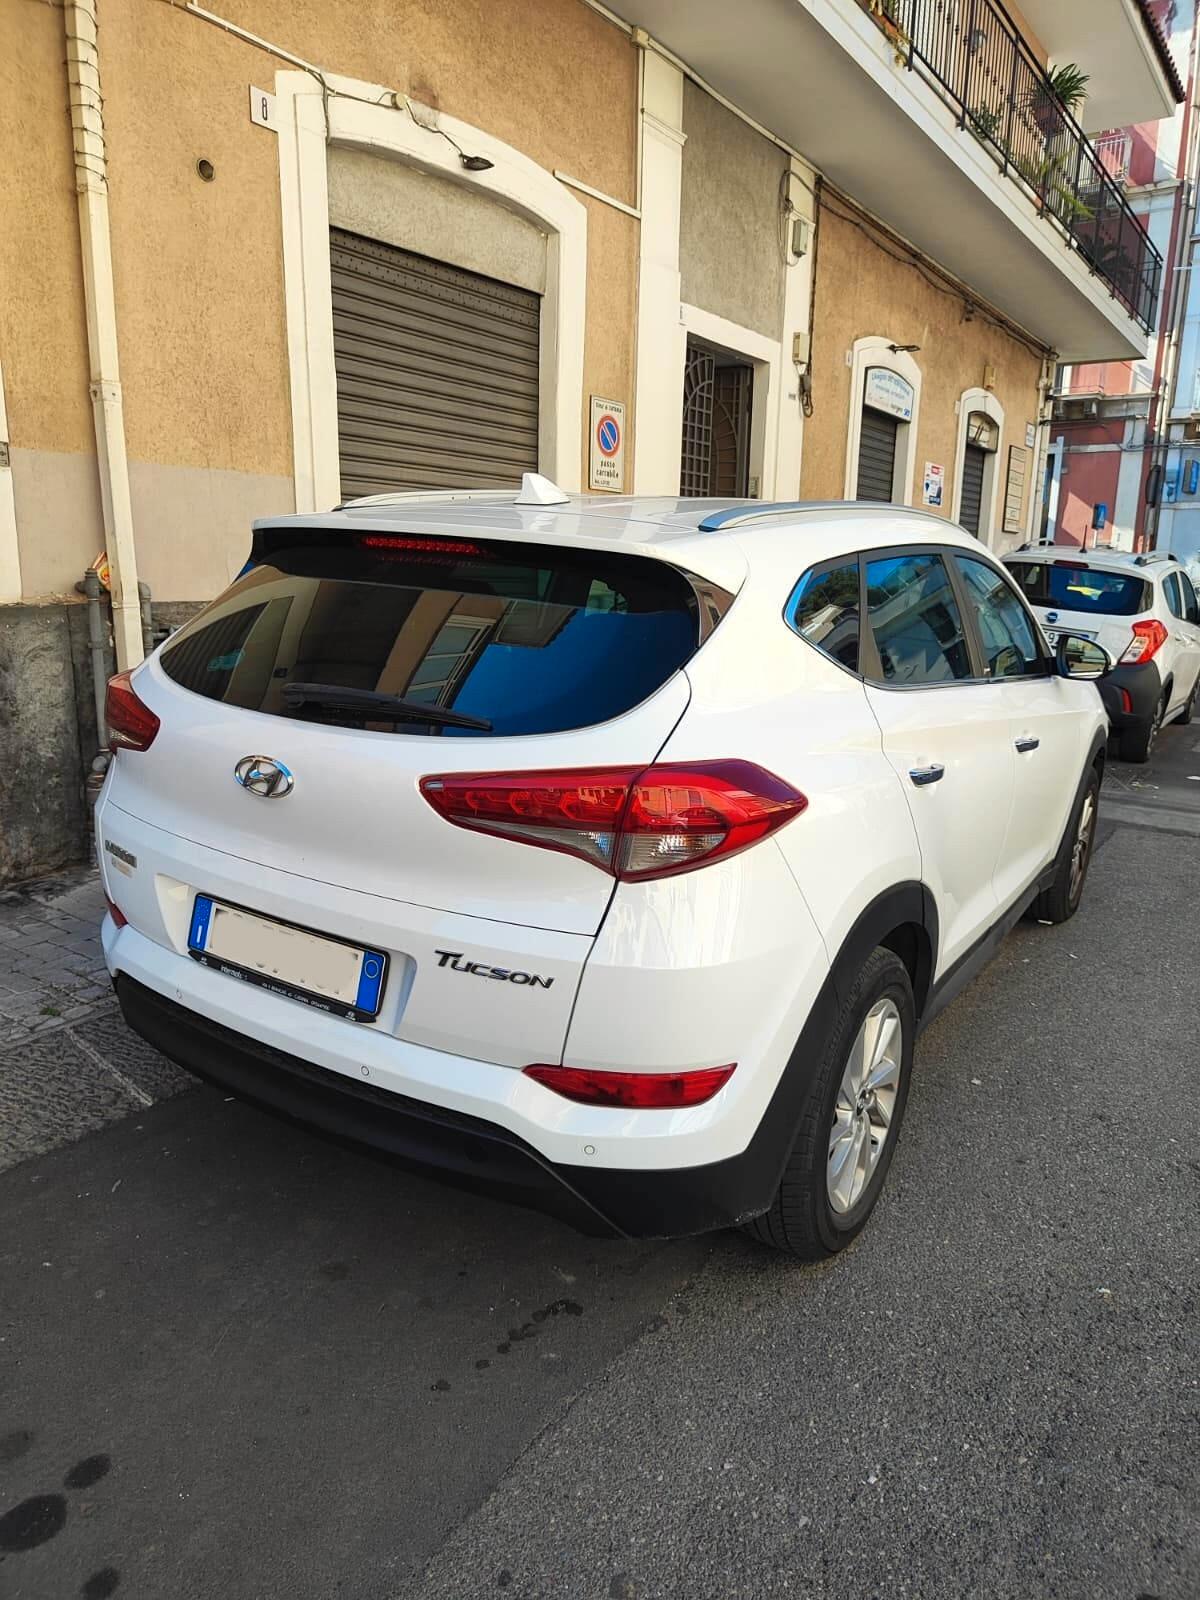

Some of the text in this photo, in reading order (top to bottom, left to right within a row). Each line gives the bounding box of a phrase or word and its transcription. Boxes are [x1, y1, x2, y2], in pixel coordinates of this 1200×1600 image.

[261, 97, 268, 120] 8
[600, 460, 615, 468] passo
[596, 469, 619, 478] carrabile
[434, 949, 555, 989] TUCSON
